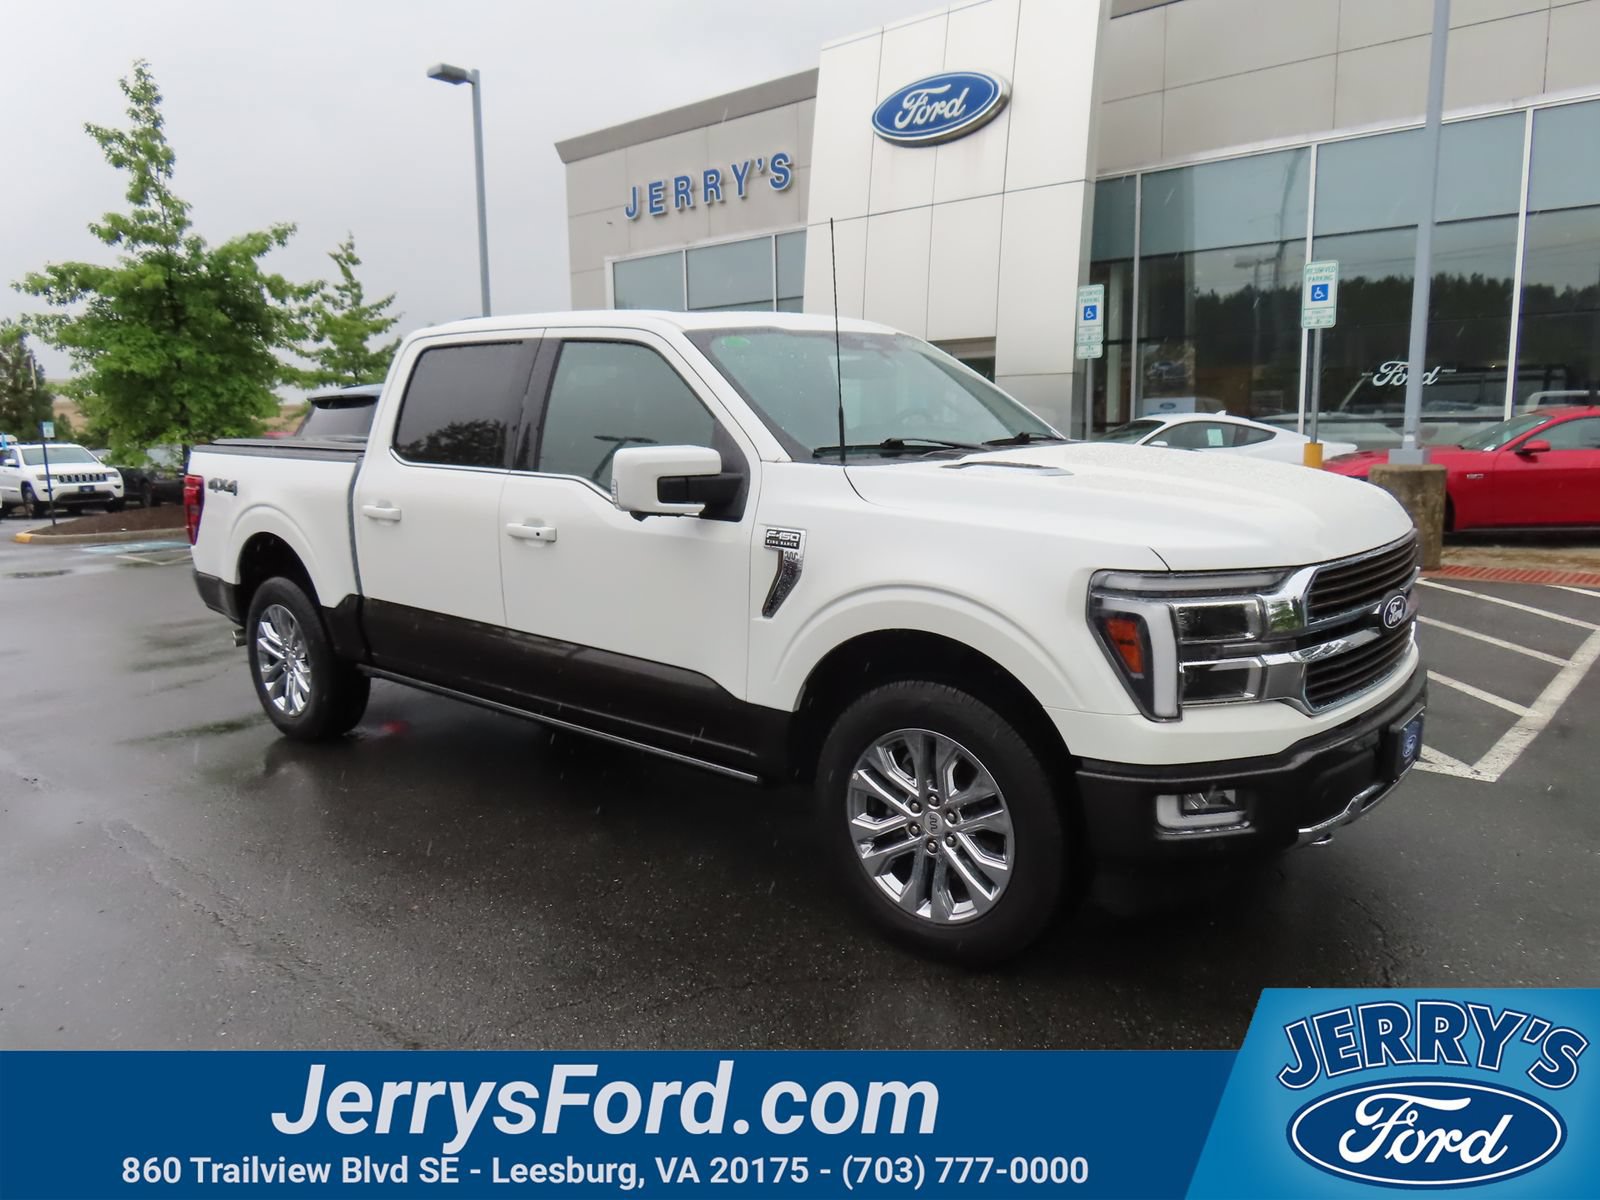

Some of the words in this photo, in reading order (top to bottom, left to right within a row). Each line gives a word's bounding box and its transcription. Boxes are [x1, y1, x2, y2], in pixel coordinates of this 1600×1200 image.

[894, 84, 970, 129] Ford
[624, 151, 794, 221] JERRY'S
[1372, 361, 1441, 387] Fod
[766, 531, 800, 541] F-150
[1388, 601, 1405, 625] Ford
